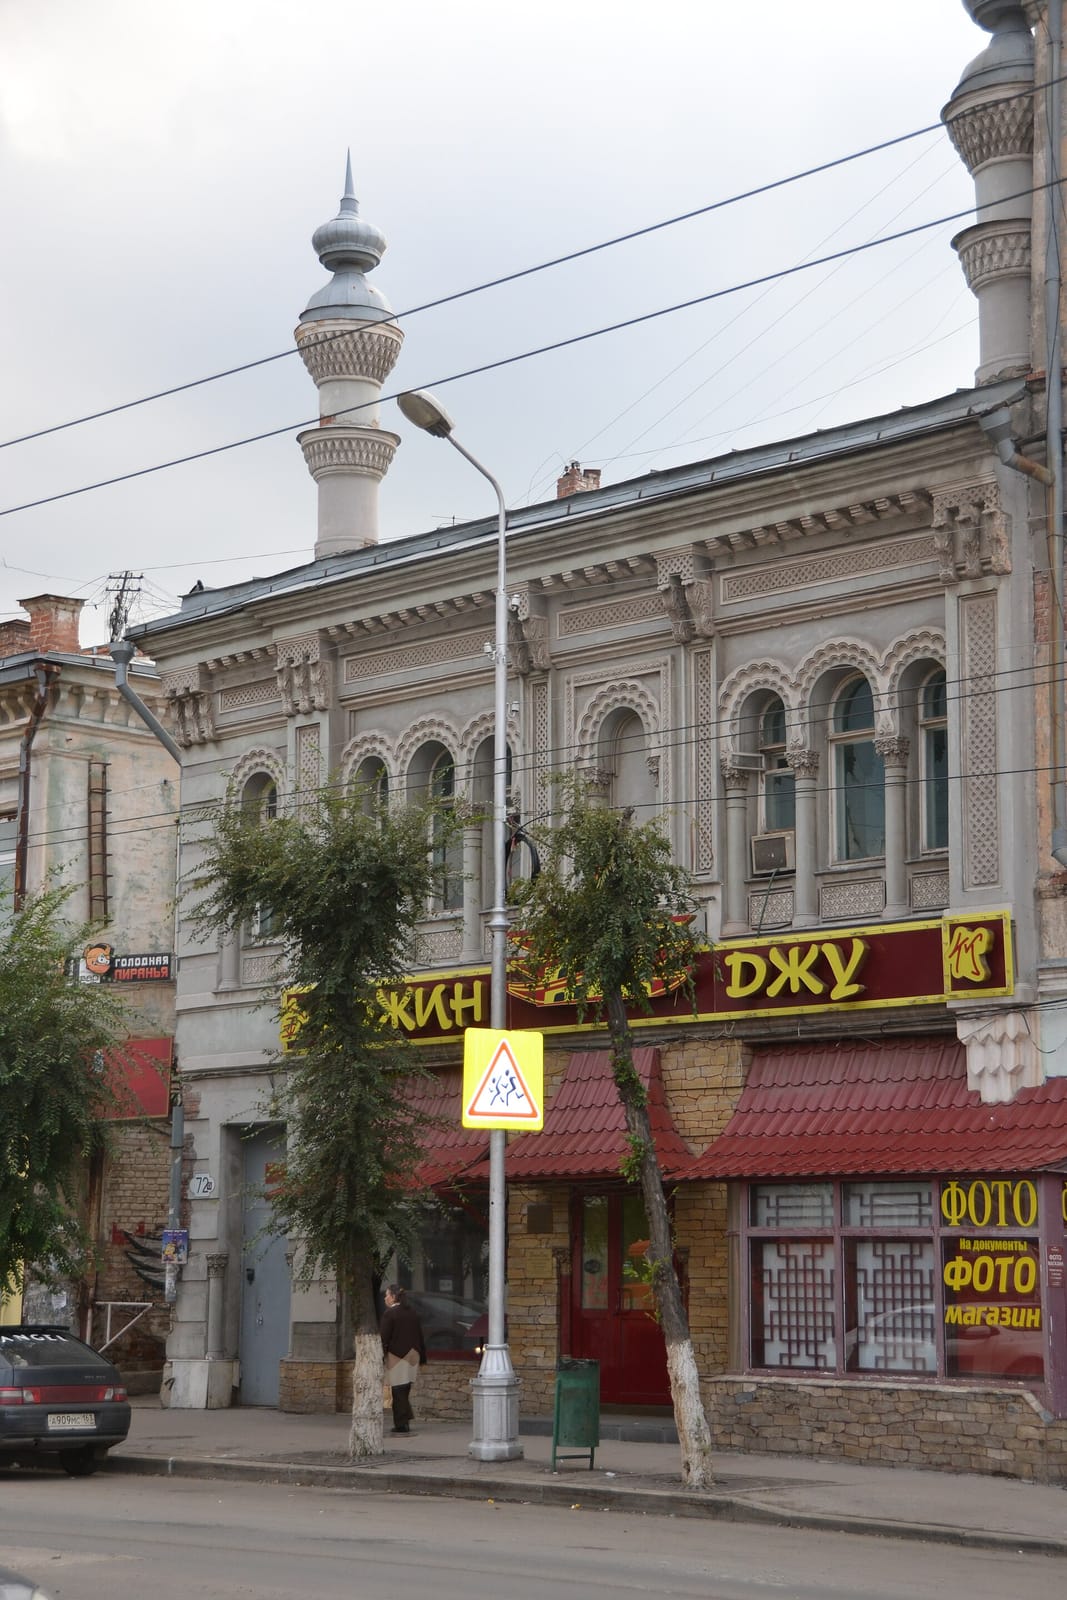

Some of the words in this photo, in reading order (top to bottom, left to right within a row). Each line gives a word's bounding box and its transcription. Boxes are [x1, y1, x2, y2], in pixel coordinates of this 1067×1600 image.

[114, 956, 169, 968] ГОЛОДНАЯ
[114, 966, 169, 980] ПИРАНЬЯ
[941, 1180, 1038, 1227] ФОТО
[960, 1238, 971, 1250] На
[973, 1239, 1027, 1252] документы
[943, 1255, 1037, 1293] ФОТО
[944, 1304, 1041, 1328] магазин
